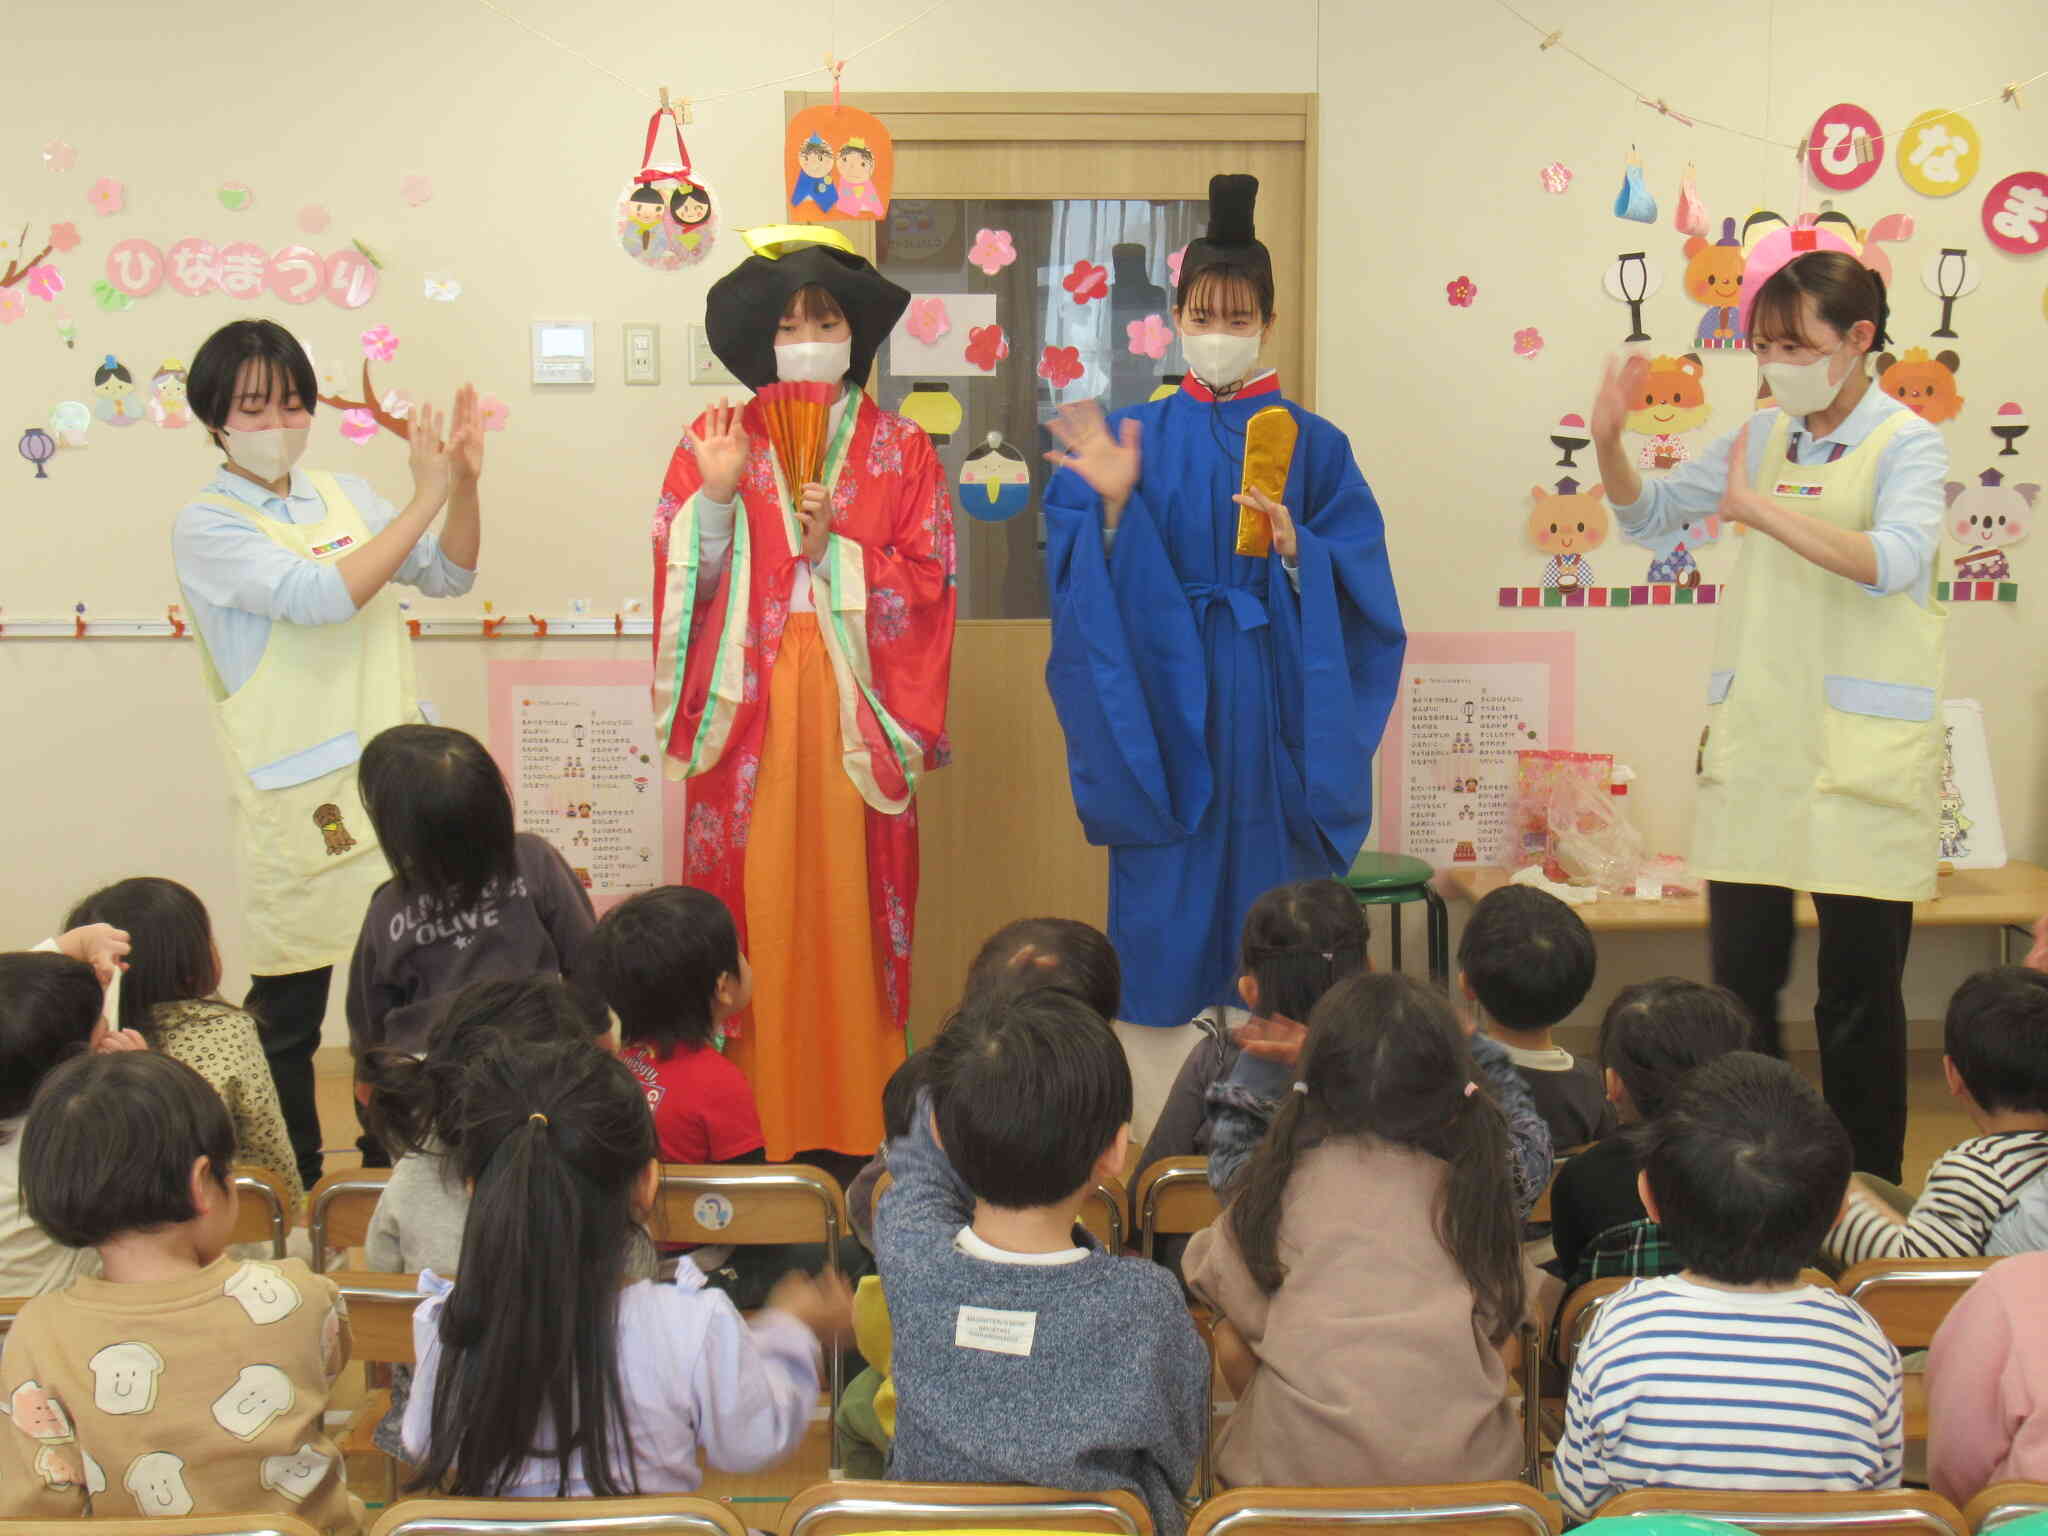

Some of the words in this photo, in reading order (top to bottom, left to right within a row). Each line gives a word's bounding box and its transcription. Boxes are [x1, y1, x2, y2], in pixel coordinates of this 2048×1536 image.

[113, 246, 369, 307] ひなまつり
[415, 908, 499, 945] OLIVE
